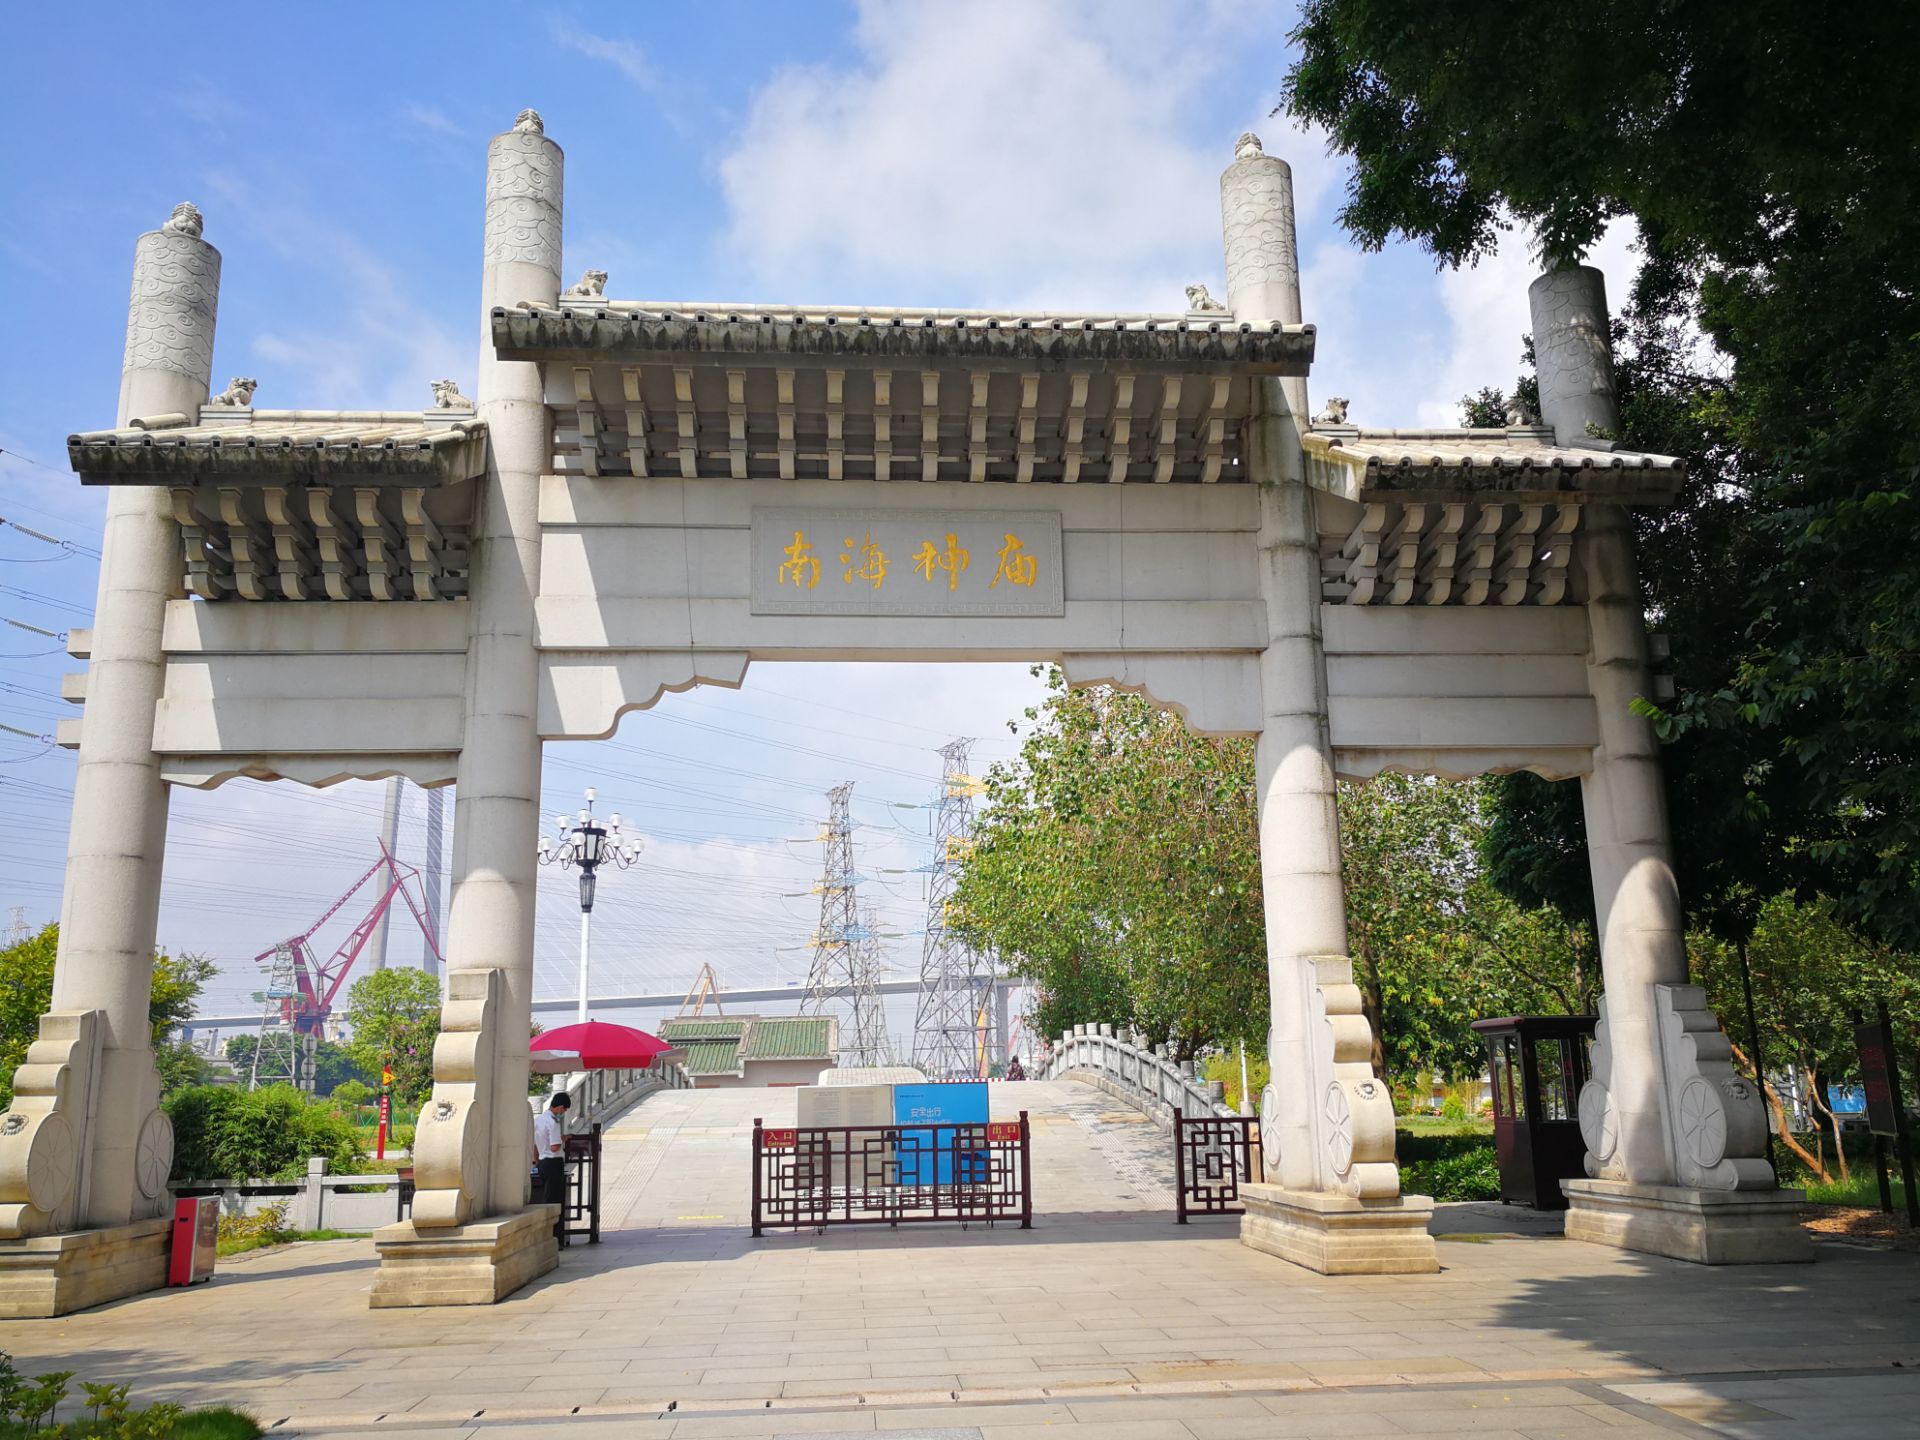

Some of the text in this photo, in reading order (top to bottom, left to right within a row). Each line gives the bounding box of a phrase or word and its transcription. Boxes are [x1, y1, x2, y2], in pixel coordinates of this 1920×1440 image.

[778, 528, 1037, 592] 南海神庙
[911, 1106, 942, 1118] 安全出行
[992, 1124, 1016, 1134] 出口
[768, 1131, 792, 1140] 入口
